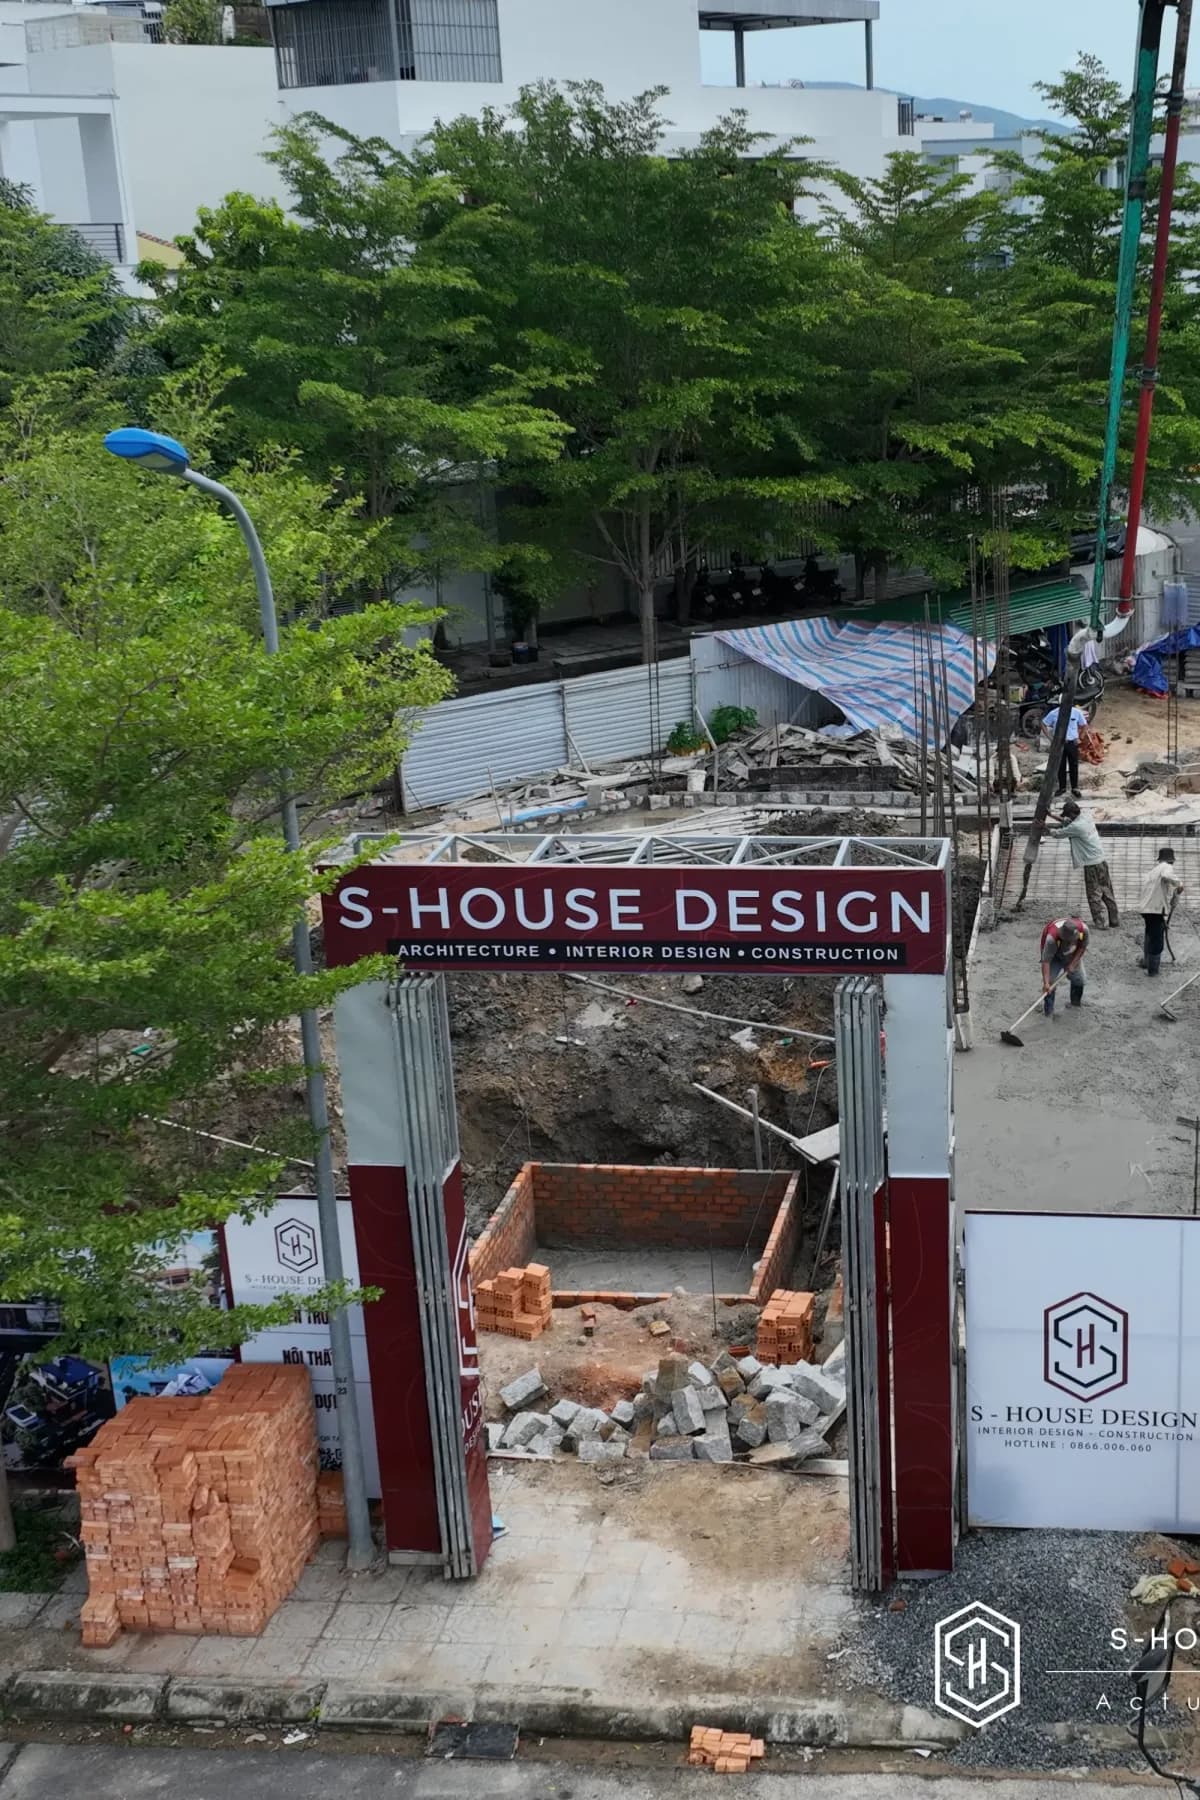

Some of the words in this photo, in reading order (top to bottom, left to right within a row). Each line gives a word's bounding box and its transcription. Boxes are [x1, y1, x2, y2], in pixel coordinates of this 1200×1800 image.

[338, 886, 644, 931] S-HOUSE
[675, 889, 931, 934] DESIGN
[398, 944, 540, 958] ARCHITECTURE
[566, 945, 654, 958] INTERIOR
[661, 947, 731, 960] DESIGN
[751, 948, 898, 961] CONSTRUCTION
[262, 1274, 305, 1286] HOUSE
[971, 1405, 983, 1422] S
[1006, 1406, 1094, 1425] HOUSE
[1102, 1409, 1198, 1428] DESIGN
[977, 1427, 1033, 1437] INTERIOR
[1039, 1428, 1084, 1438] DESIGN
[1098, 1430, 1194, 1442] CONSTRUCTION
[1004, 1439, 1056, 1449] HOTLINE
[1070, 1441, 1152, 1453] 0866.006.060
